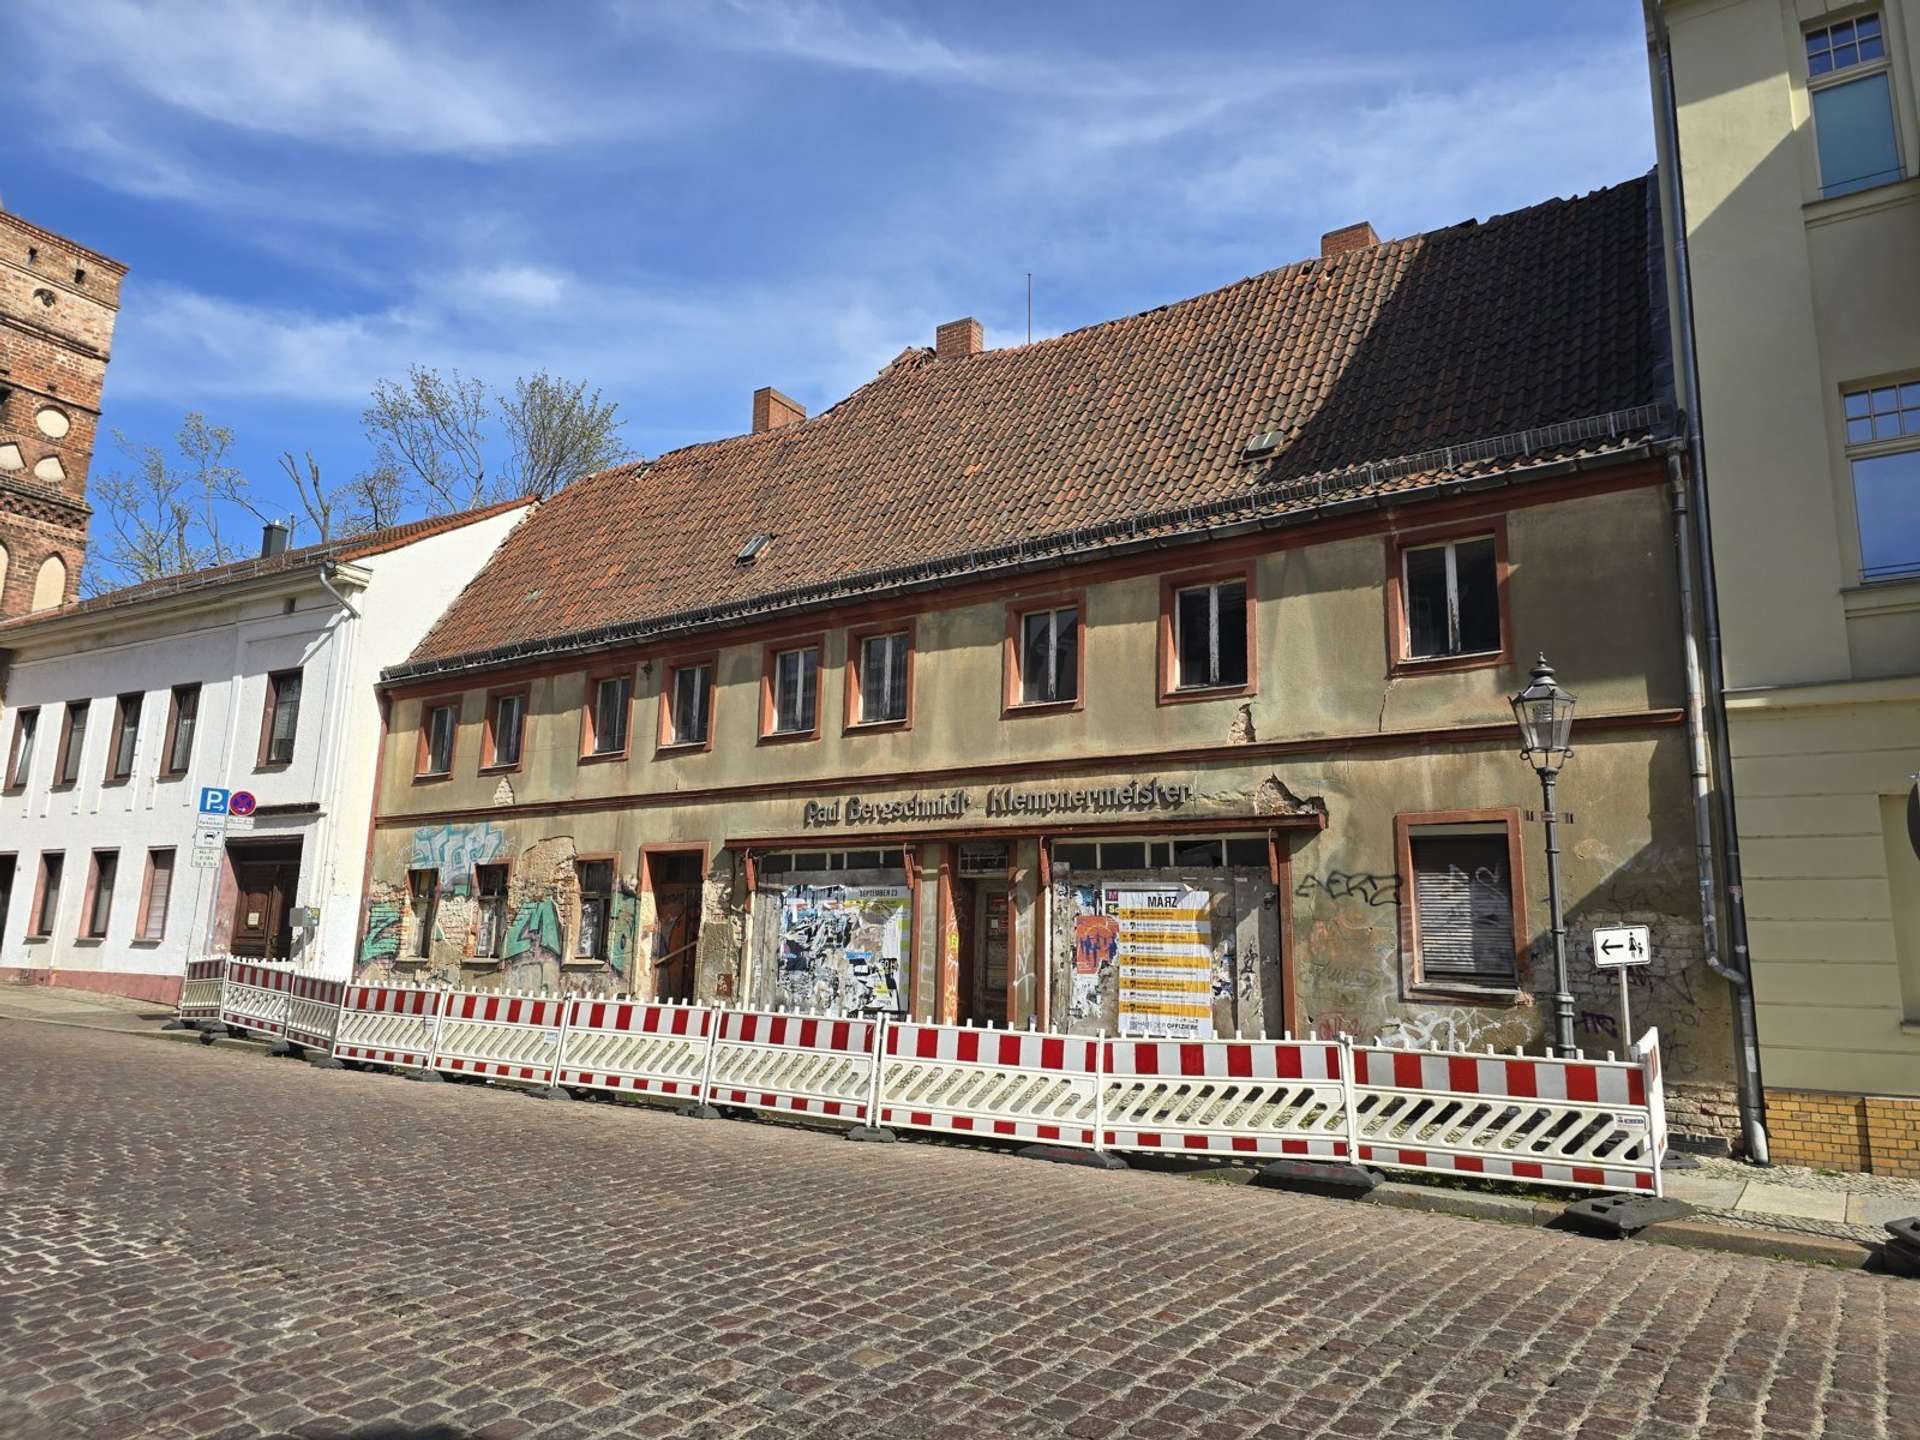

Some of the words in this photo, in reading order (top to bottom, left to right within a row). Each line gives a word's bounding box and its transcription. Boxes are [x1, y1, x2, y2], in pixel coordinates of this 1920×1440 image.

[205, 790, 223, 810] P
[805, 799, 841, 825] Paul
[848, 790, 970, 823] Bergschmidt
[989, 778, 1193, 812] Klempnermeister
